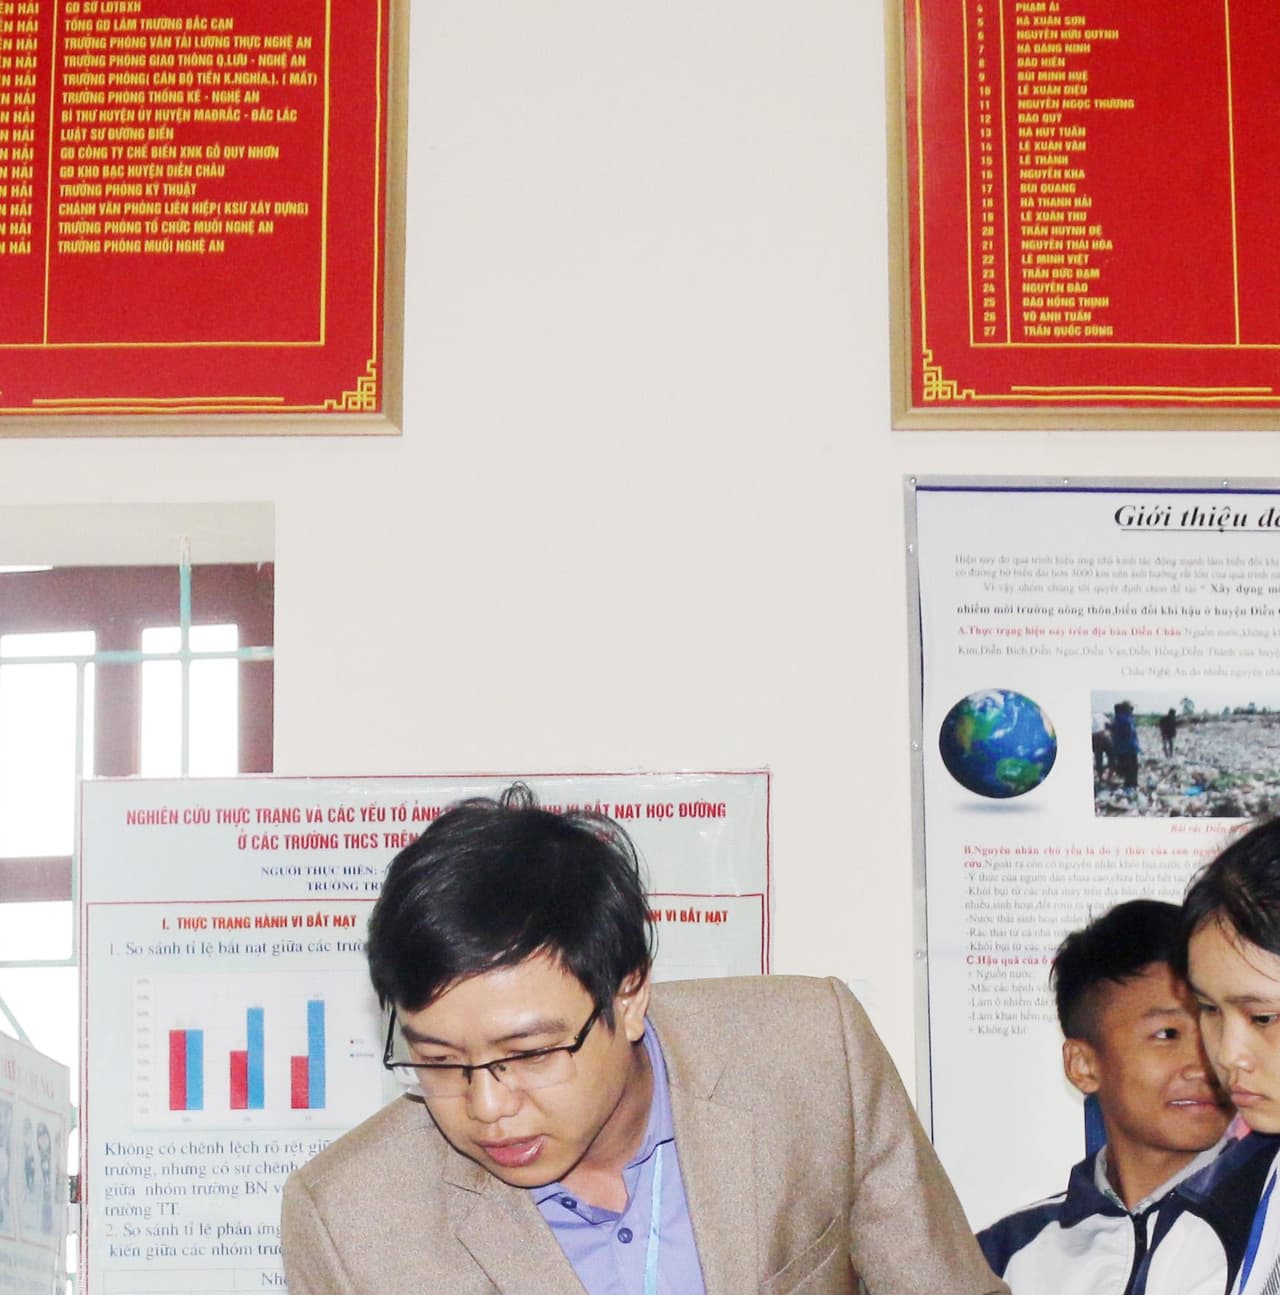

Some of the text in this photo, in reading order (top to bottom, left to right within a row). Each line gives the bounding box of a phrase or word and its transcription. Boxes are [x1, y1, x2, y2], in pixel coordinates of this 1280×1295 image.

[1114, 504, 1172, 527] Giới
[1180, 506, 1248, 532] thiệu
[237, 828, 247, 850] Ở
[251, 830, 279, 850] CÁC
[285, 830, 339, 850] TRƯỜNG
[344, 834, 378, 849] THCS
